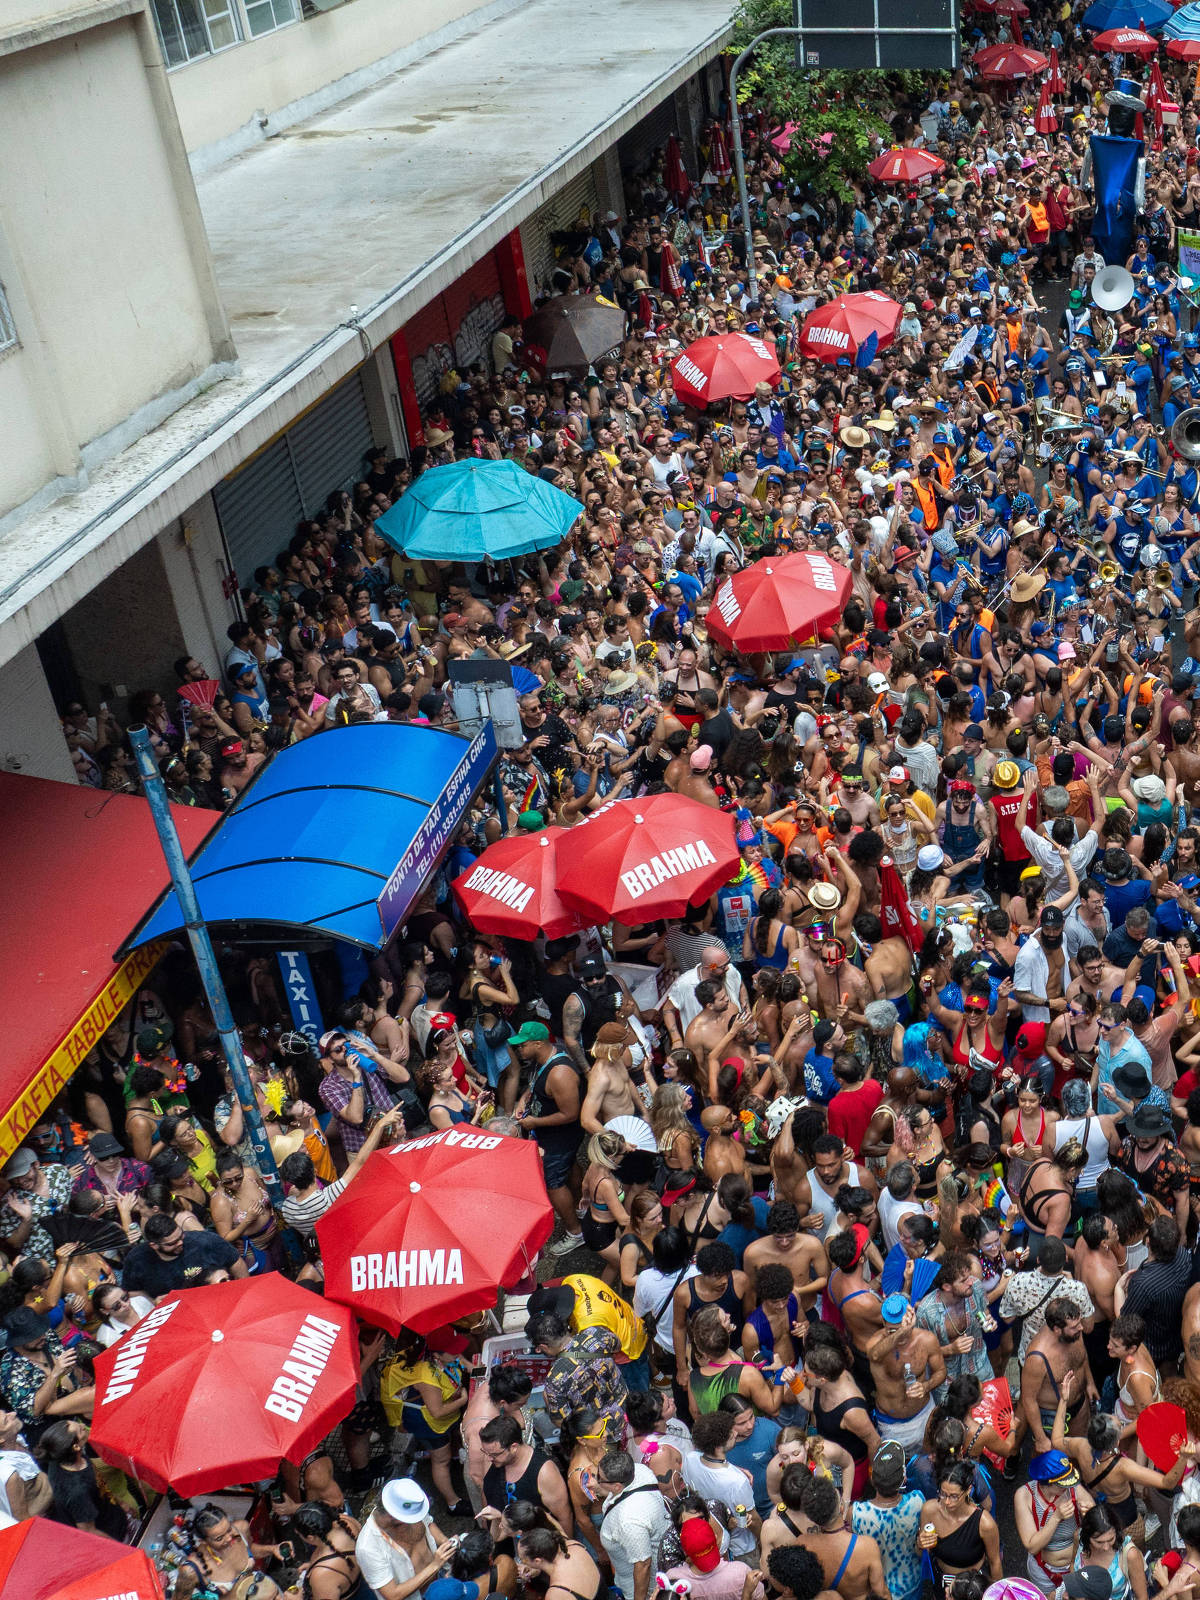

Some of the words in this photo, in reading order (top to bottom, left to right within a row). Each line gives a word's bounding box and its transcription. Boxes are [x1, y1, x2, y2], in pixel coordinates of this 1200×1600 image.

[1117, 34, 1150, 43] BRAHMA
[736, 332, 773, 360] BRA
[807, 326, 850, 350] BRAHMA
[675, 354, 709, 392] BRAHMA
[804, 553, 837, 592] BRA
[387, 854, 414, 901] PONTO
[412, 836, 425, 855] DE
[423, 807, 442, 838] TAXI
[446, 759, 472, 803] ESFIHA
[470, 732, 488, 763] CHIC
[430, 831, 443, 859] (11)
[441, 783, 472, 834] 3331-1815
[463, 865, 536, 913] BRAHMA
[620, 839, 718, 900] BRAHMA
[124, 941, 166, 989] PRA
[281, 951, 311, 1022] TAXI
[388, 1128, 505, 1155] BRAHMA
[350, 1248, 465, 1293] BRAHMA
[100, 1299, 182, 1407] BRAHMA
[263, 1313, 343, 1424] BRAHMA
